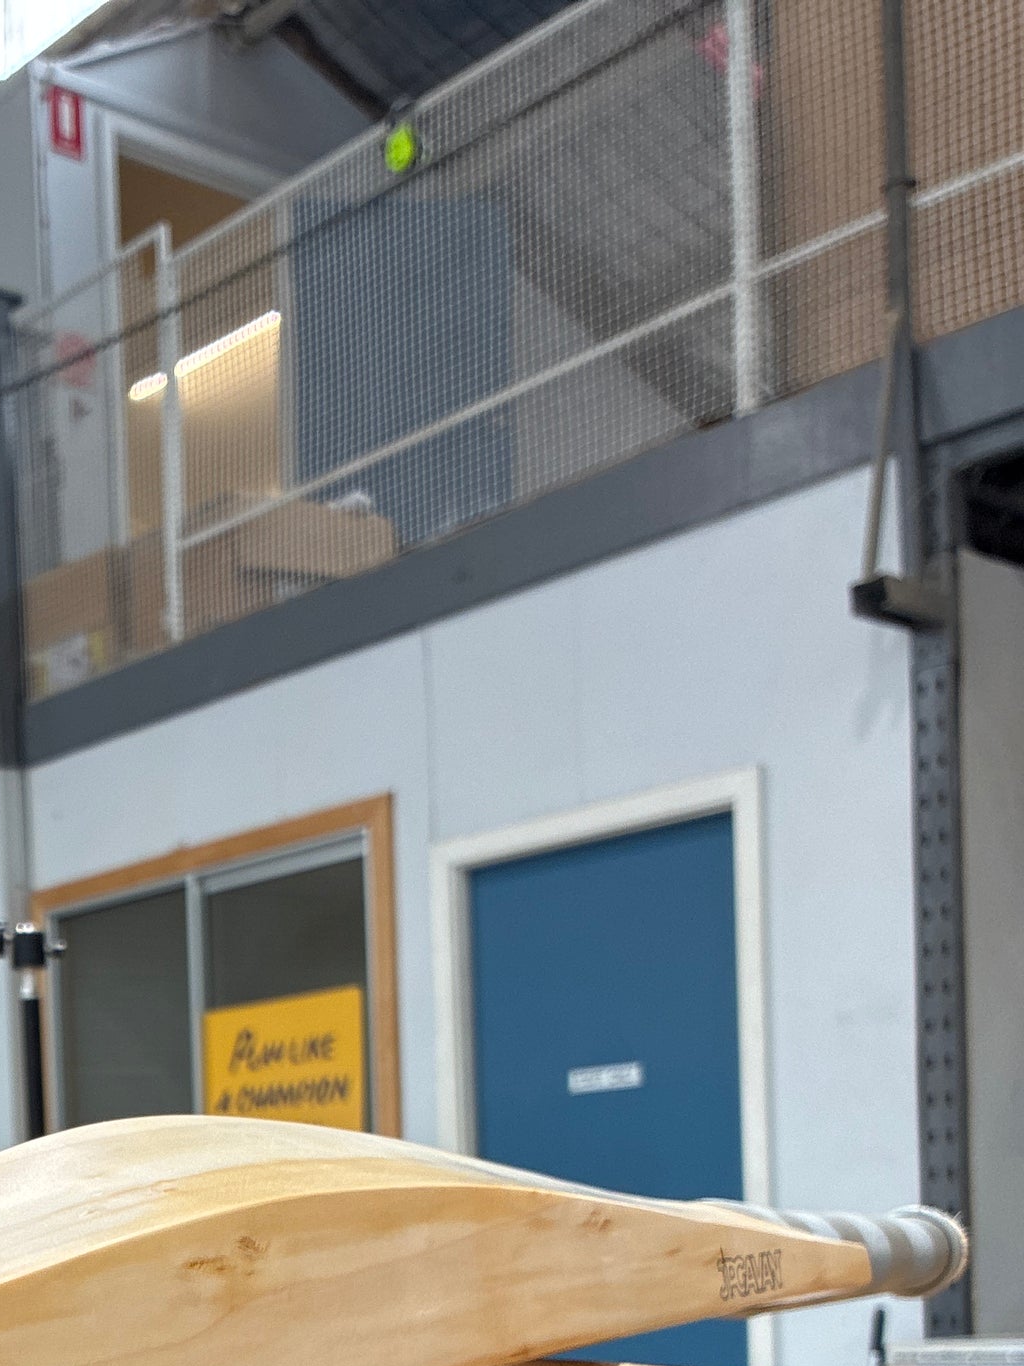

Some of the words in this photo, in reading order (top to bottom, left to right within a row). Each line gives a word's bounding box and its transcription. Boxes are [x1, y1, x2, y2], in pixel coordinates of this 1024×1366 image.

[288, 1032, 336, 1065] LIKE
[215, 1089, 232, 1113] A
[236, 1074, 350, 1112] CHAMPION
